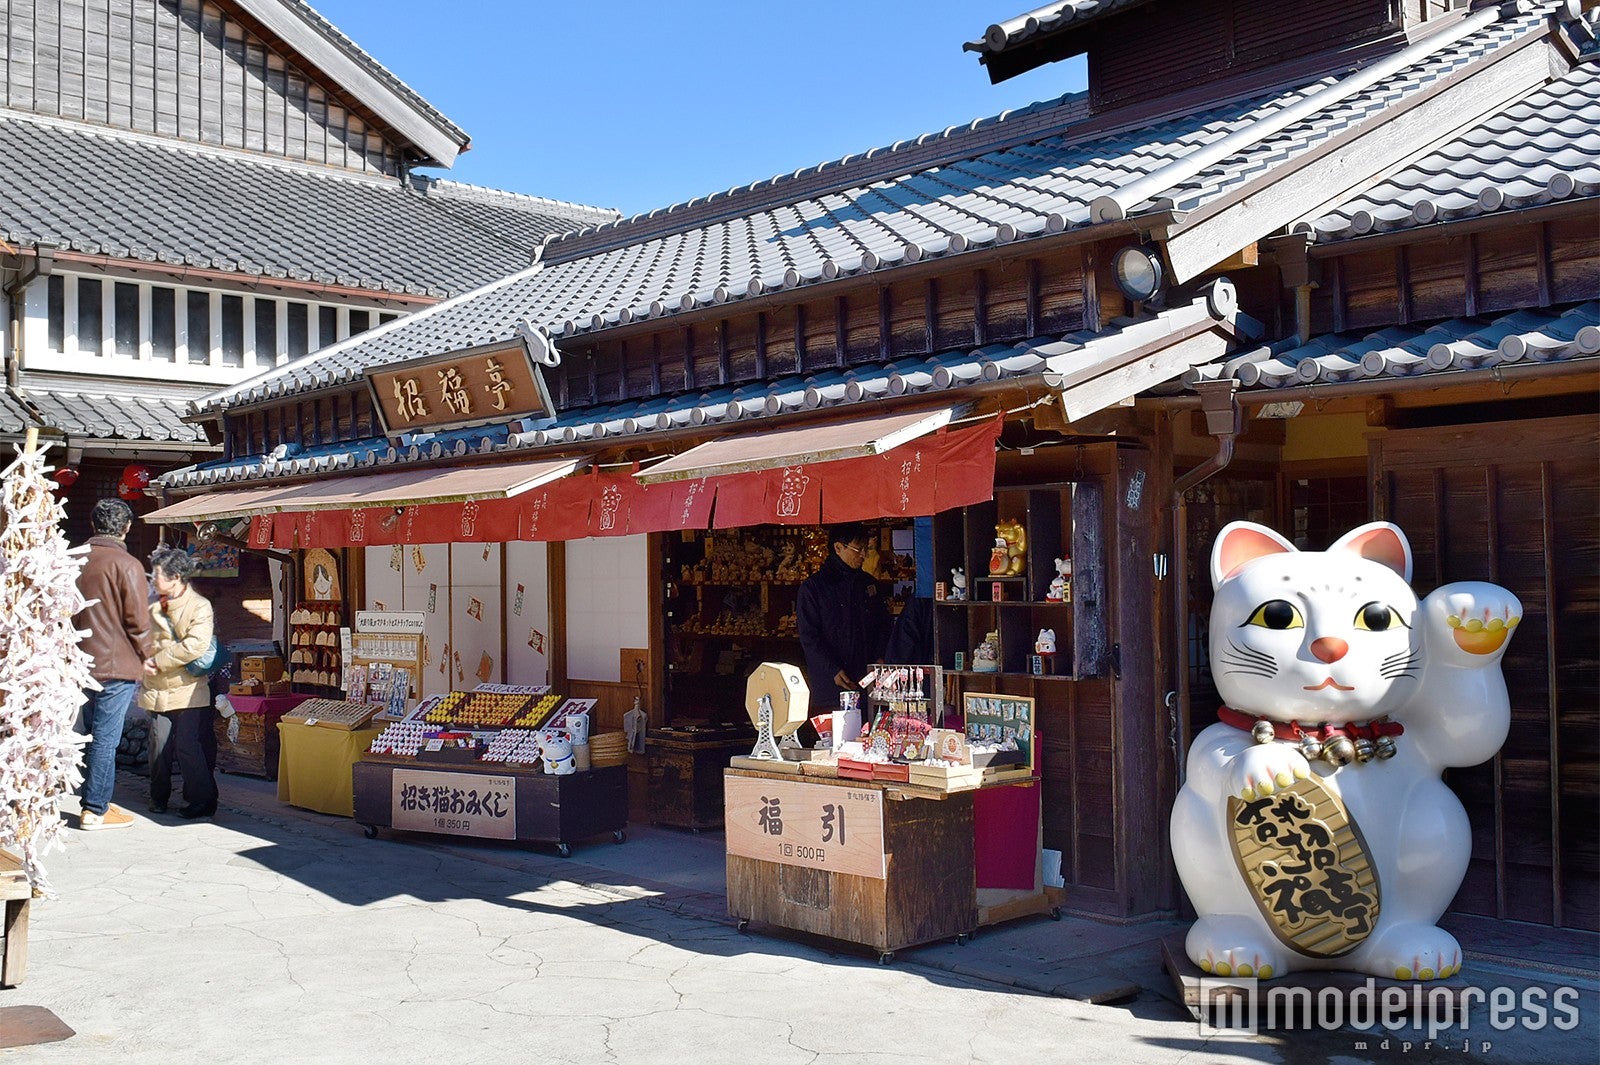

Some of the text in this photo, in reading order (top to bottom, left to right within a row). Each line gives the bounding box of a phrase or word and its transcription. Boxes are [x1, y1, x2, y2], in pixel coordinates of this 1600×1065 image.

[393, 357, 511, 422] 招福亭
[400, 783, 510, 818] 招き猫おみくじ
